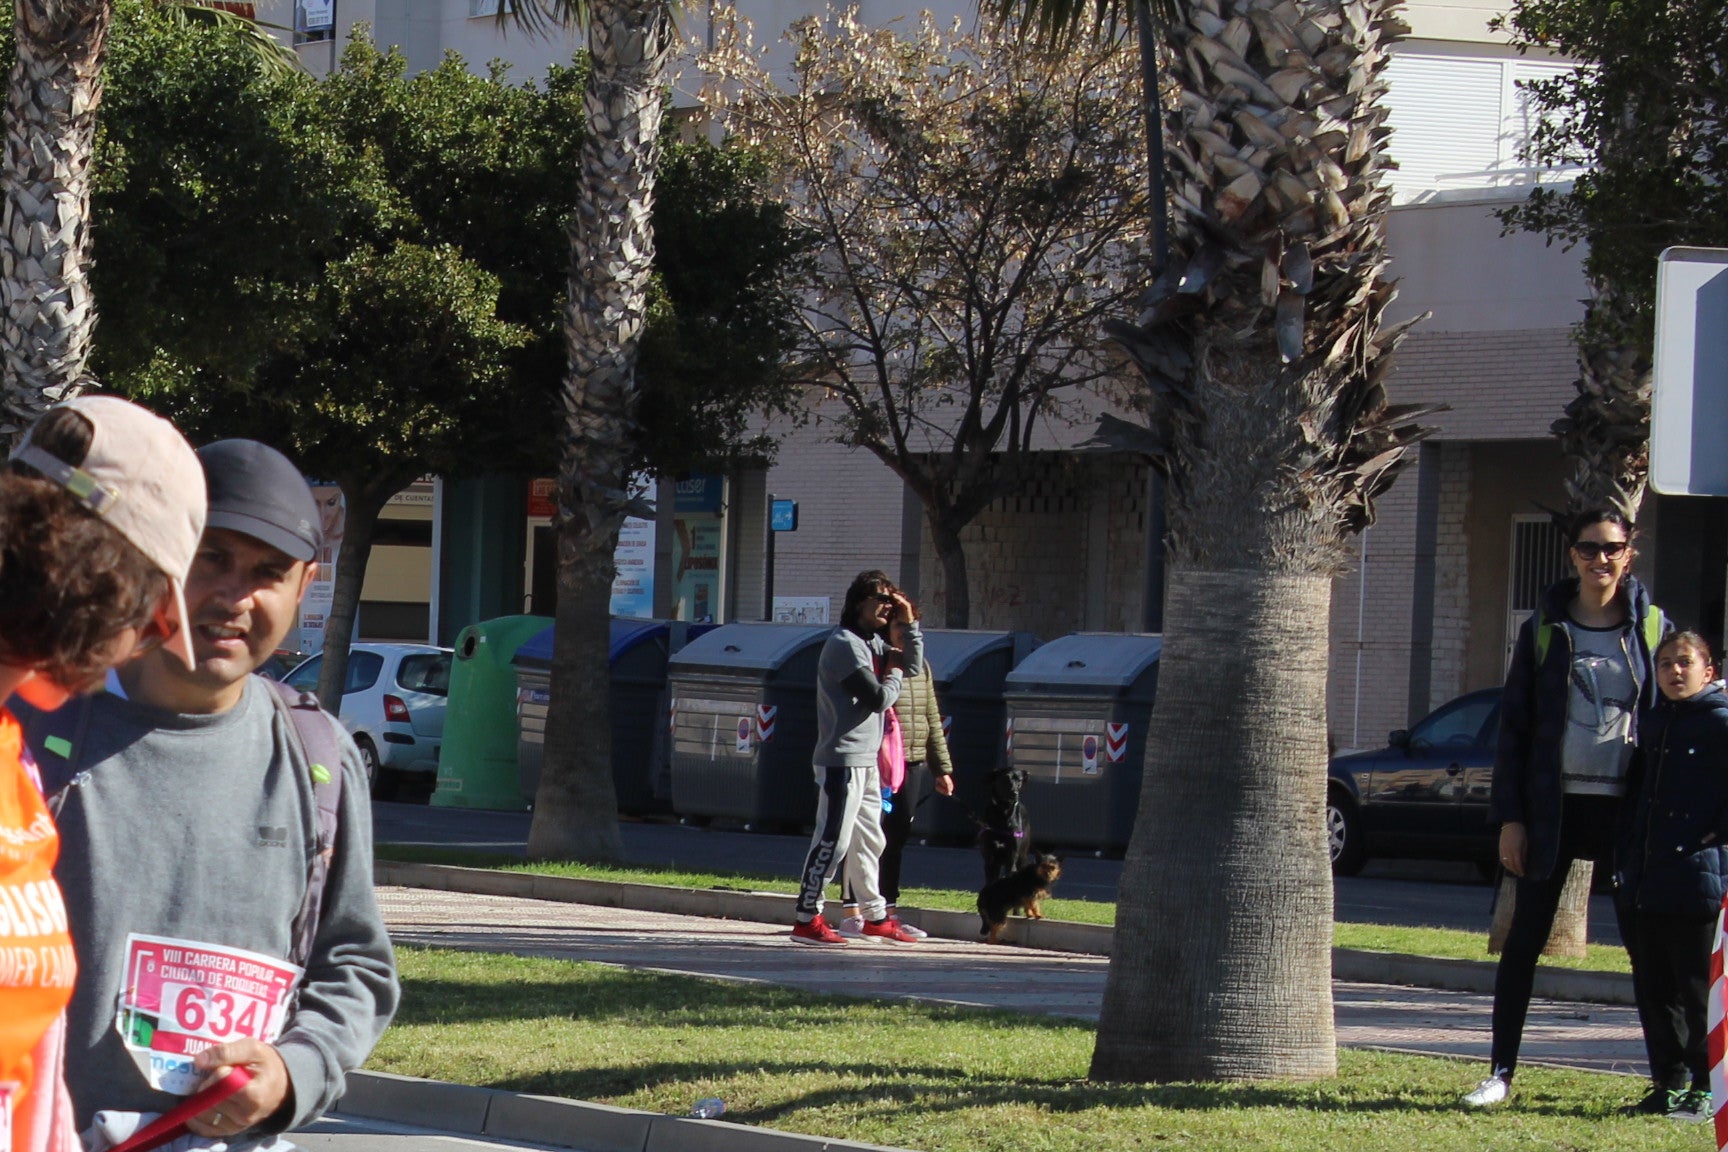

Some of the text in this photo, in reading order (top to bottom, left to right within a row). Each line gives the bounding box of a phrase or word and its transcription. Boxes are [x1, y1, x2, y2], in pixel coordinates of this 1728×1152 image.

[802, 840, 835, 909] mistral
[40, 944, 78, 989] CAM
[160, 965, 269, 998] CIUDAD DE ROQUETAS
[163, 948, 275, 983] VIII CARRERA POPULAR
[175, 987, 259, 1037] 634
